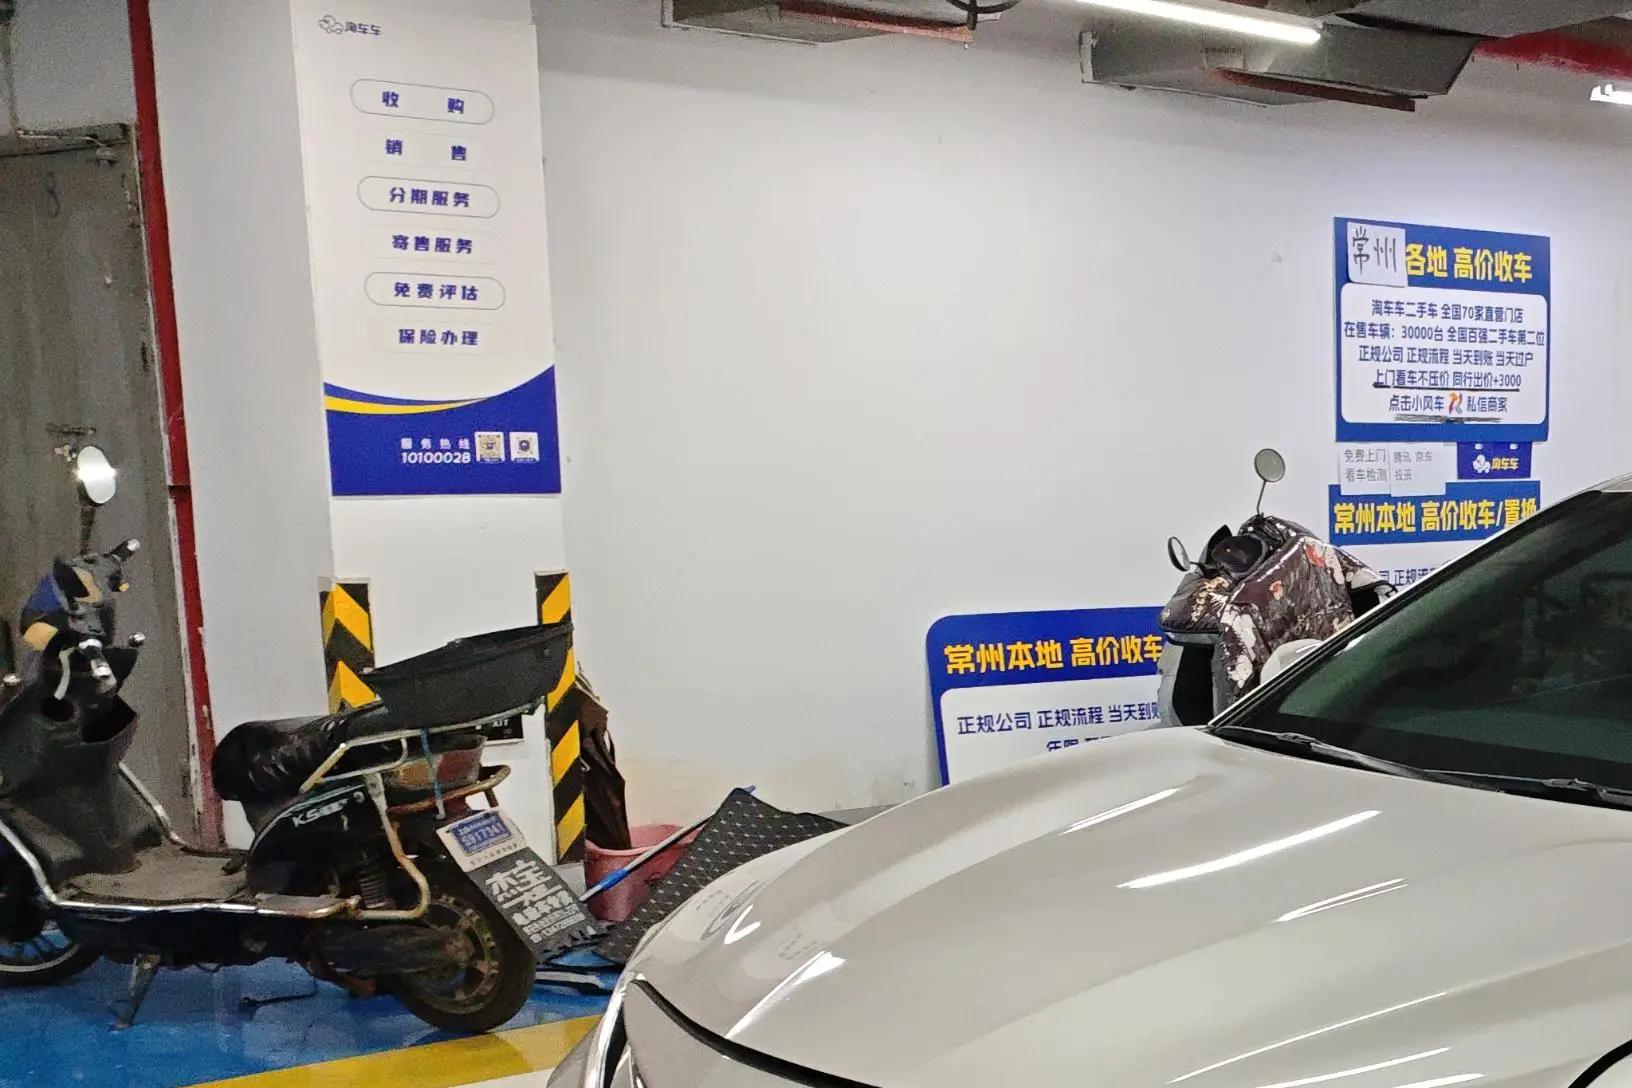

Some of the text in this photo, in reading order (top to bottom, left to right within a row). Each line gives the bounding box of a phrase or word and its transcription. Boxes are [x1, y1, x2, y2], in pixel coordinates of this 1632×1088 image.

[345, 21, 383, 36] 淘车车
[382, 91, 465, 114] 收购
[386, 139, 467, 162] 销售
[389, 187, 470, 208] 分期服务
[392, 234, 473, 255] 寄售服务
[1352, 226, 1397, 275] 常州
[1405, 243, 1532, 283] 各地 高价收车
[393, 282, 479, 302] 免费评估
[1371, 299, 1524, 324] 淘车车二手车 全国70家直营门店
[398, 328, 479, 347] 保险办理
[1447, 326, 1545, 347] 全国百强二手车第二位
[1359, 345, 1534, 367] 正规公司 正规流程 当天到账 当天过户
[1373, 369, 1522, 388] 上门看车不压价 同行出价+3000
[1389, 394, 1508, 413] 点击小风车 私信商家
[402, 451, 471, 464] 10100028
[1344, 448, 1386, 463] 免费上门
[1491, 457, 1519, 470] 淘车车
[1345, 468, 1388, 482] 看车检测
[1334, 502, 1416, 534] 常州本地
[944, 634, 1163, 675] 常州本地 高价收车
[957, 712, 1032, 735] 正规公司
[1038, 707, 1104, 729] 正规流程
